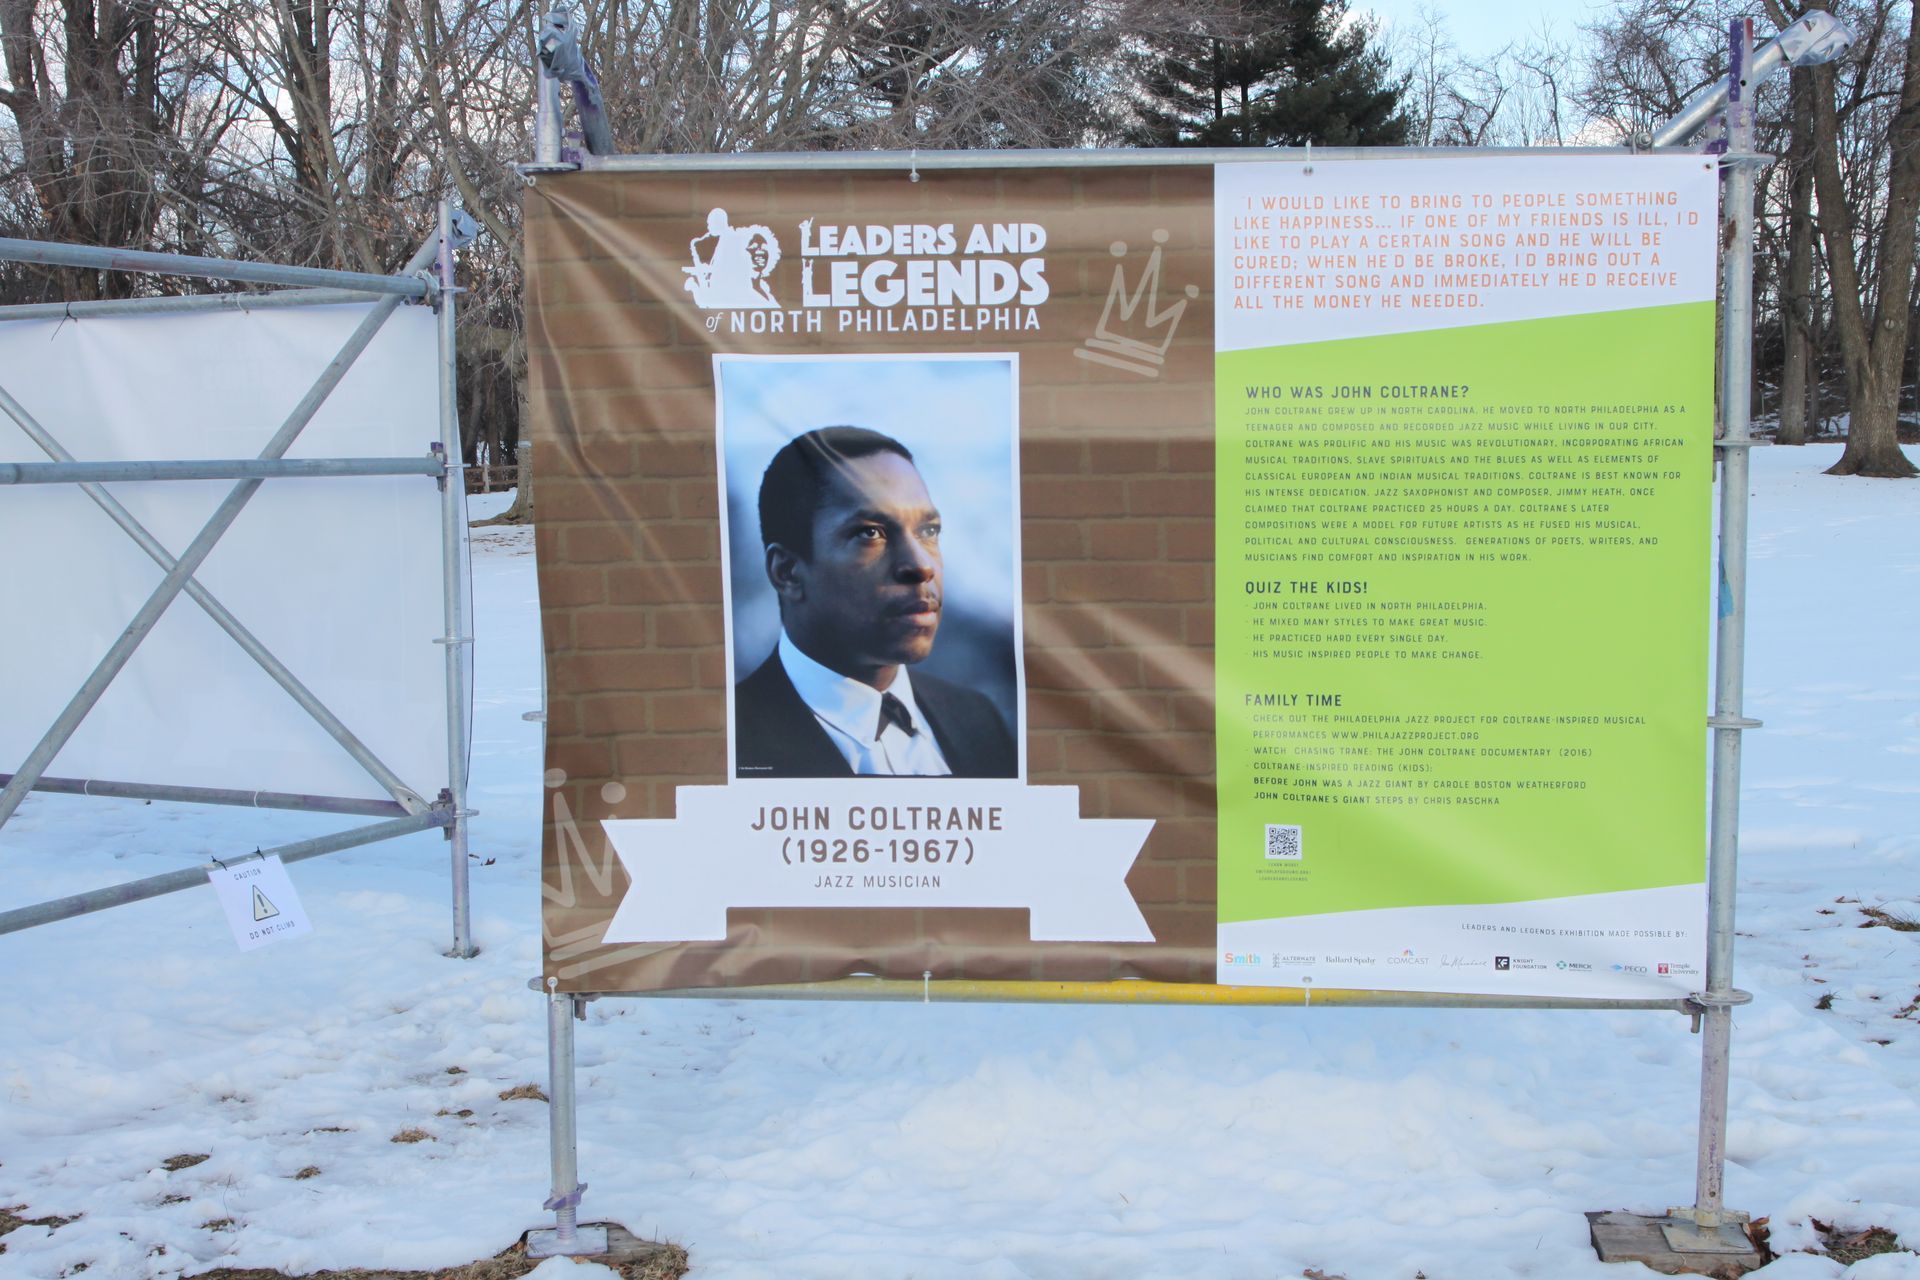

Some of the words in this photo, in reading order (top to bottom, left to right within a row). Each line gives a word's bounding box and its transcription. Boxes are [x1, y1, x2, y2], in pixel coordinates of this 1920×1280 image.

[1261, 196, 1324, 210] WOULD
[1334, 196, 1370, 209] LIKE
[1379, 195, 1400, 209] TO
[1411, 195, 1462, 209] BRING
[1472, 194, 1493, 208] TO
[1502, 194, 1566, 207] PEOPLE
[1576, 192, 1677, 206] SOMETHING
[1234, 216, 1270, 230] LIKE
[1280, 215, 1391, 230] HAPPINESS...
[1401, 215, 1415, 228] IF
[1425, 214, 1458, 228] ONE
[1468, 214, 1488, 227] OF
[1498, 214, 1521, 227] MY
[1531, 212, 1603, 227] FRIENDS
[1614, 212, 1629, 226] IS
[1638, 212, 1668, 226] ILL,
[799, 218, 955, 256] LEADERS
[963, 222, 1048, 254] AND
[1234, 236, 1270, 249] LIKE
[1280, 235, 1300, 249] TO
[1310, 235, 1350, 249] PLAY
[1359, 235, 1369, 248] A
[1378, 234, 1450, 248] CERTAIN
[1460, 234, 1506, 247] SONG
[1515, 233, 1549, 247] AND
[1560, 233, 1580, 246] HE
[1590, 232, 1632, 246] WILL
[1642, 232, 1661, 246] BE
[1307, 255, 1356, 268] WHEN
[1415, 254, 1434, 268] BE
[1546, 252, 1597, 266] BRING
[1608, 252, 1641, 266] OUT
[1650, 252, 1660, 266] A
[801, 258, 1050, 308] LEGENDS
[1234, 275, 1326, 289] DIFFERENT
[1335, 274, 1380, 288] SONG
[1390, 274, 1424, 288] AND
[1434, 273, 1549, 288] IMMEDIATELY
[1606, 272, 1677, 286] RECEIVE
[1234, 296, 1263, 309] ALL
[1272, 295, 1304, 309] THE
[1314, 294, 1372, 308] MONEY
[1382, 294, 1402, 308] HE
[705, 311, 723, 334] of
[730, 310, 822, 333] NORTH
[838, 308, 1041, 333] PHILADELPHIA
[1246, 386, 1281, 398] WHO
[1290, 386, 1323, 398] WAS
[1331, 386, 1371, 398] JOHN
[1380, 385, 1469, 398] COLTRANE?
[1245, 440, 1293, 448] COLTRANE
[1324, 440, 1367, 448] PROLIFIC
[1416, 440, 1446, 448] MUSIC
[1562, 438, 1639, 447] INCORPORATING
[1245, 521, 1317, 529] COMPOSITIONS
[1328, 553, 1373, 561] COMFORT
[1402, 553, 1461, 561] INSPIRATION
[1480, 553, 1495, 561] HIS
[1246, 581, 1281, 594] QUIZ
[1290, 582, 1318, 593] THE
[1326, 582, 1367, 593] KIDS!
[1253, 602, 1278, 610] JOHN
[1282, 602, 1330, 610] COLTRANE
[1335, 602, 1362, 610] LIVED
[1366, 602, 1376, 610] IN
[1380, 602, 1412, 610] NORTH
[1416, 602, 1487, 610] PHILADELPHIA.
[1253, 618, 1264, 626] HE
[1270, 618, 1299, 626] MIXED
[1334, 618, 1368, 626] STYLES
[1372, 618, 1385, 626] TO
[1389, 618, 1414, 626] MAKE
[1420, 618, 1449, 626] GREAT
[1454, 618, 1487, 626] MUSIC.
[1253, 634, 1264, 642] HE
[1270, 634, 1322, 642] PRACTICED
[1326, 634, 1352, 642] HARD
[1356, 634, 1385, 642] EVERY
[1390, 634, 1423, 642] SINGLE
[1253, 650, 1269, 658] HIS
[1273, 650, 1303, 658] MUSIC
[1308, 650, 1351, 658] INSPIRED
[1395, 651, 1407, 659] TO
[1246, 694, 1298, 706] FAMILY
[1306, 694, 1342, 706] TIME
[1253, 730, 1327, 739] PERFORMANCES
[1331, 731, 1479, 740] WWW.PHILAJAZZPROJECT.ORG
[751, 806, 831, 831] JOHN
[848, 806, 1003, 831] COLTRANE
[782, 836, 975, 866] (1926-1967)
[233, 868, 261, 880] CAUTION
[814, 875, 854, 888] JAZZ
[863, 875, 941, 888] MUSICIAN
[249, 930, 260, 940] DO
[262, 926, 274, 936] NOT
[1462, 923, 1497, 931] LEADERS
[1520, 927, 1556, 935] LEGENDS
[1560, 929, 1605, 937] EXHIBITION
[1634, 930, 1671, 938] POSSIBLE
[1224, 952, 1261, 964] Smith
[1387, 957, 1430, 965] COMCAST
